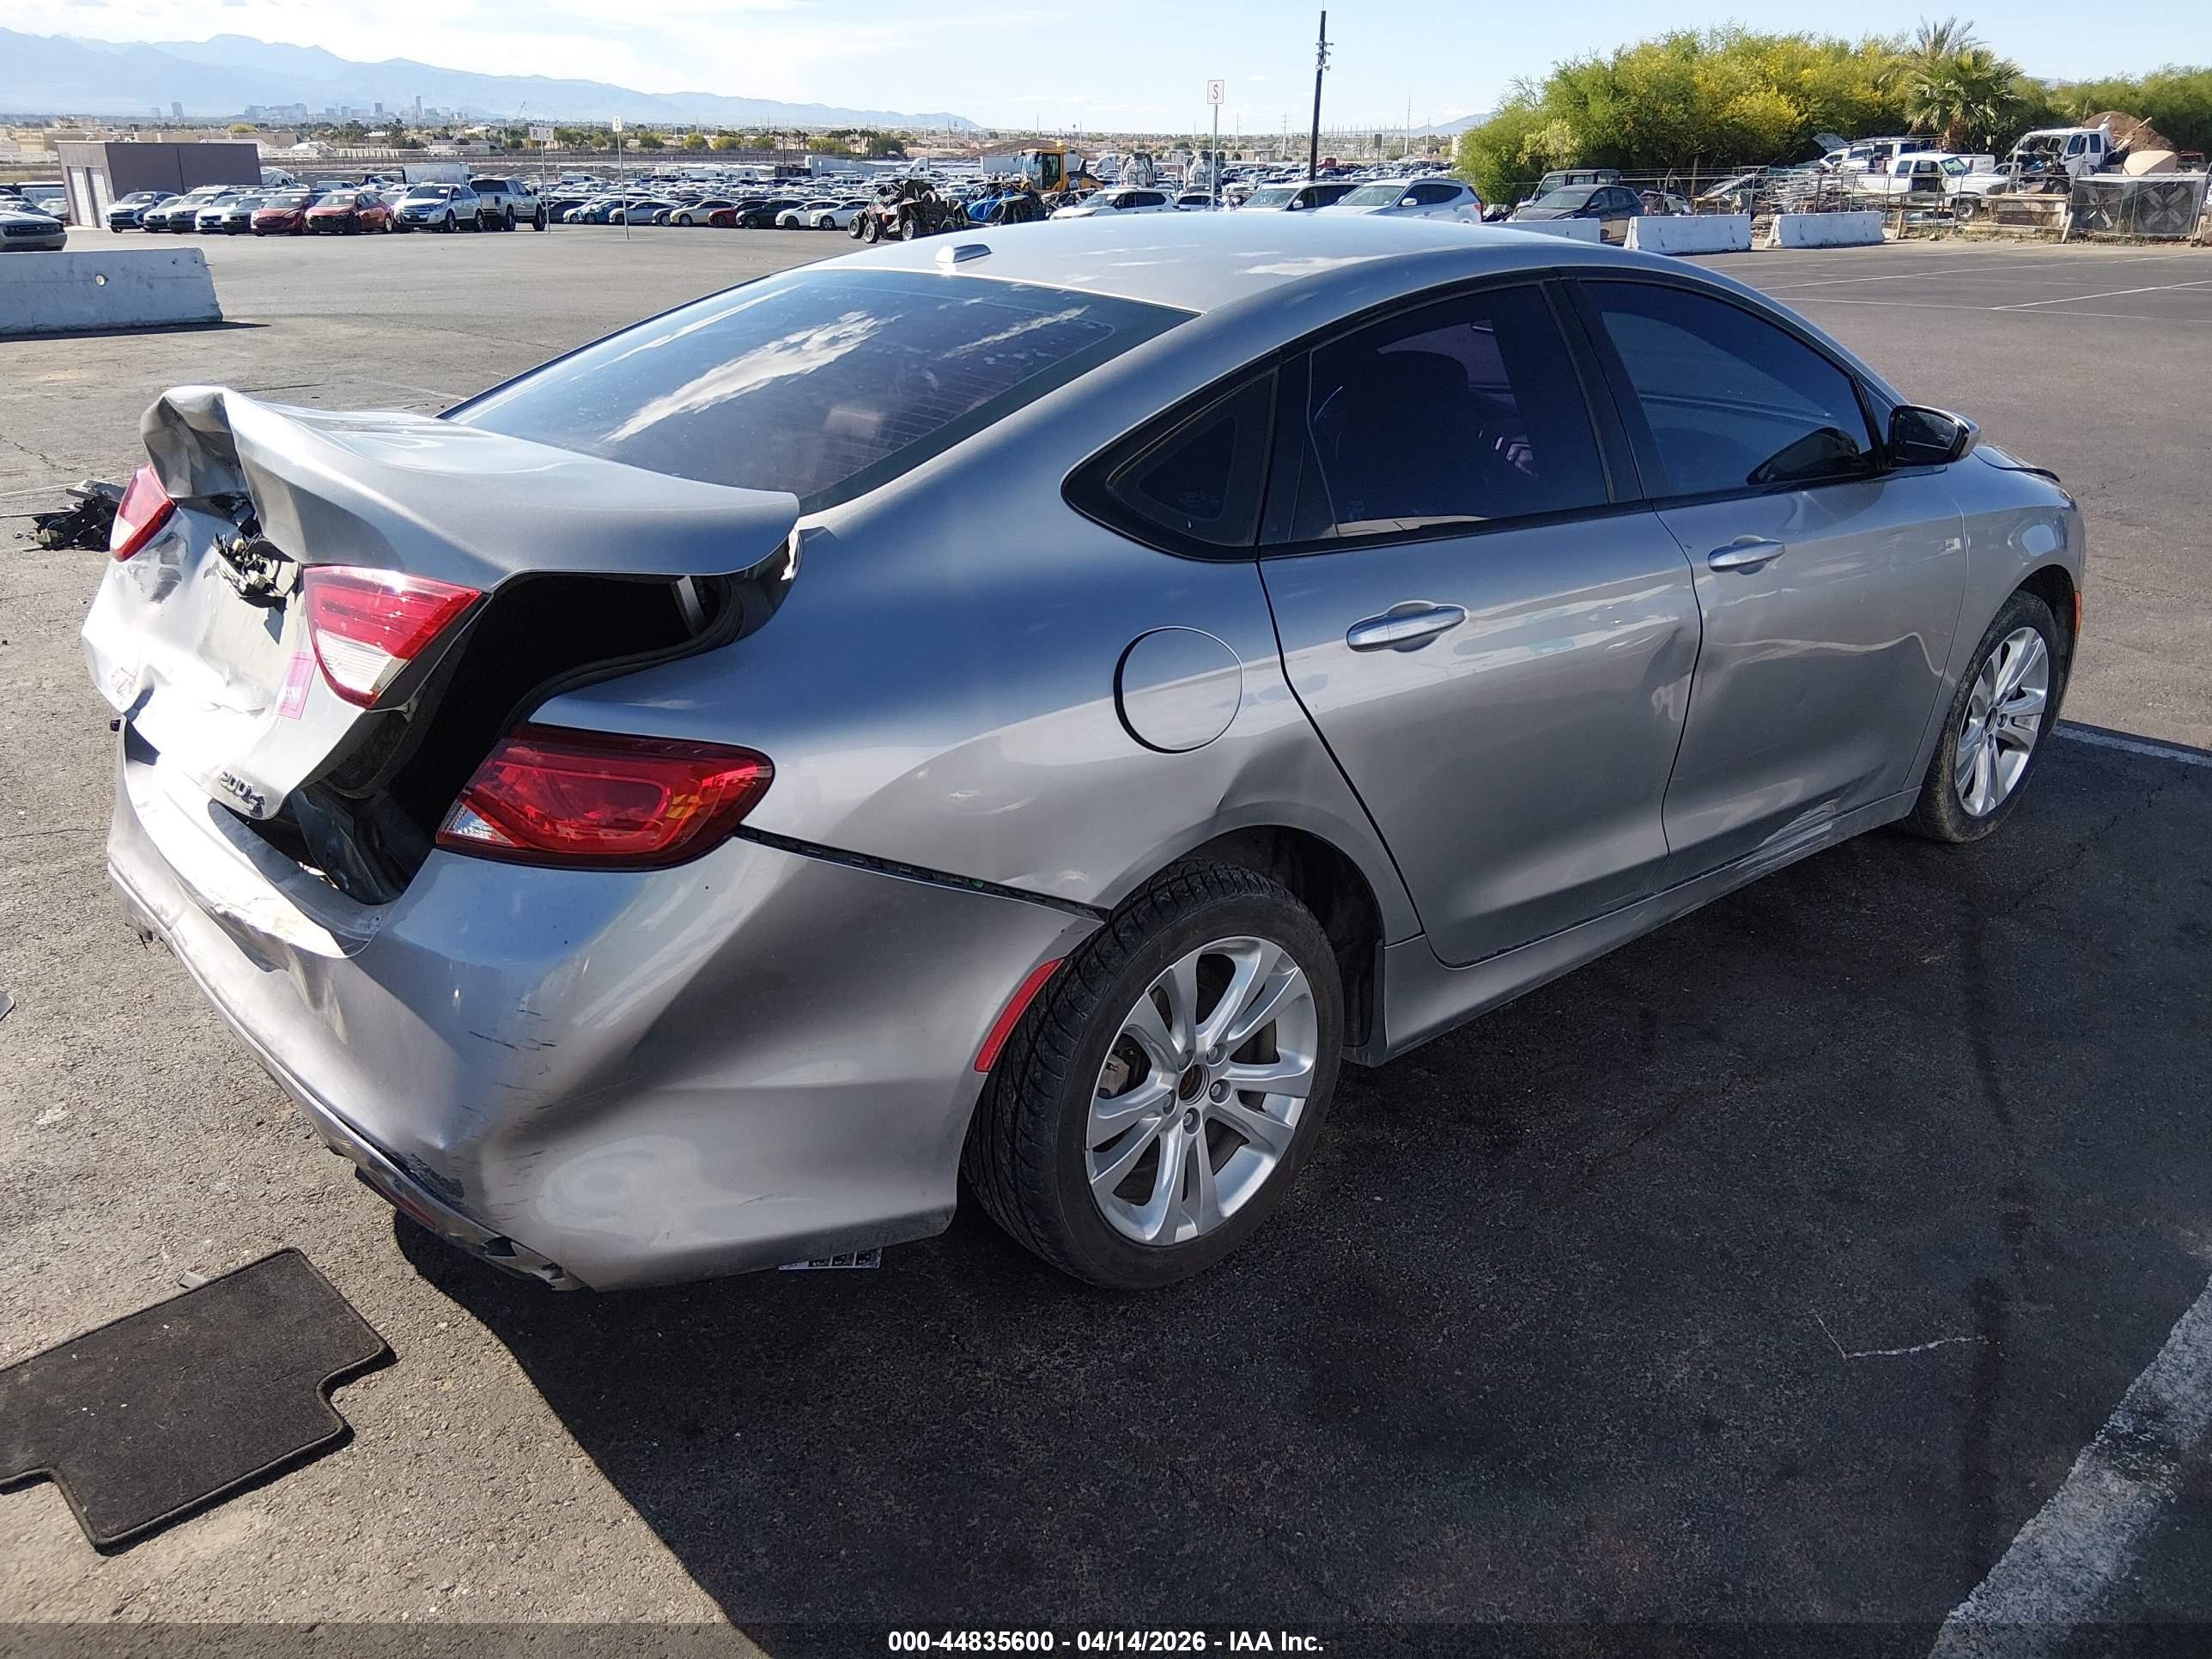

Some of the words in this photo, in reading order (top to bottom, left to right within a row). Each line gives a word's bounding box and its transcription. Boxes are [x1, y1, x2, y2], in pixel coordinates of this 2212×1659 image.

[1212, 83, 1219, 100] S
[532, 129, 538, 138] R
[546, 130, 551, 139] S
